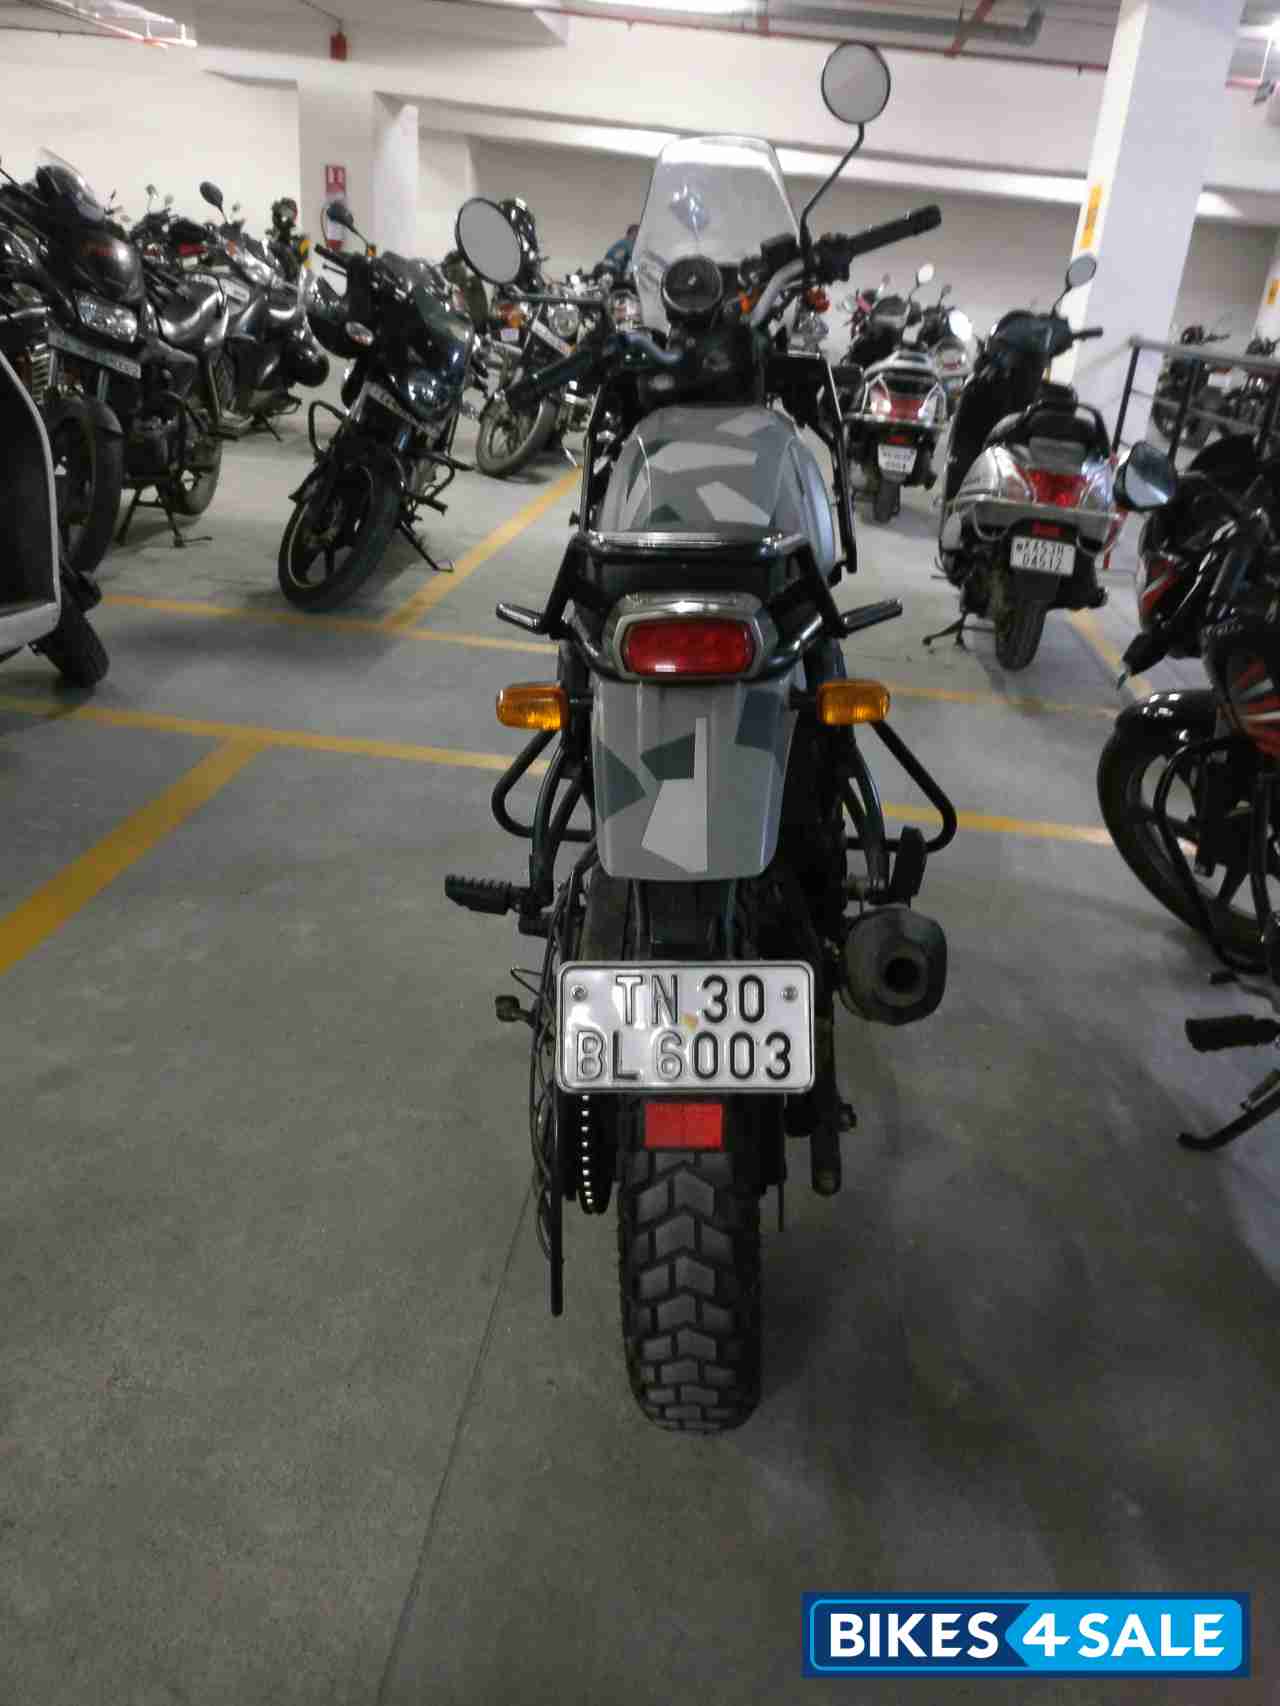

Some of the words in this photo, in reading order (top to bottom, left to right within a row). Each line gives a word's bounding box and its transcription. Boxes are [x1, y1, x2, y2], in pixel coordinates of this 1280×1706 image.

[616, 974, 678, 1025] TN
[702, 974, 766, 1024] 30
[576, 1030, 639, 1081] BL
[656, 1030, 792, 1081] 6003
